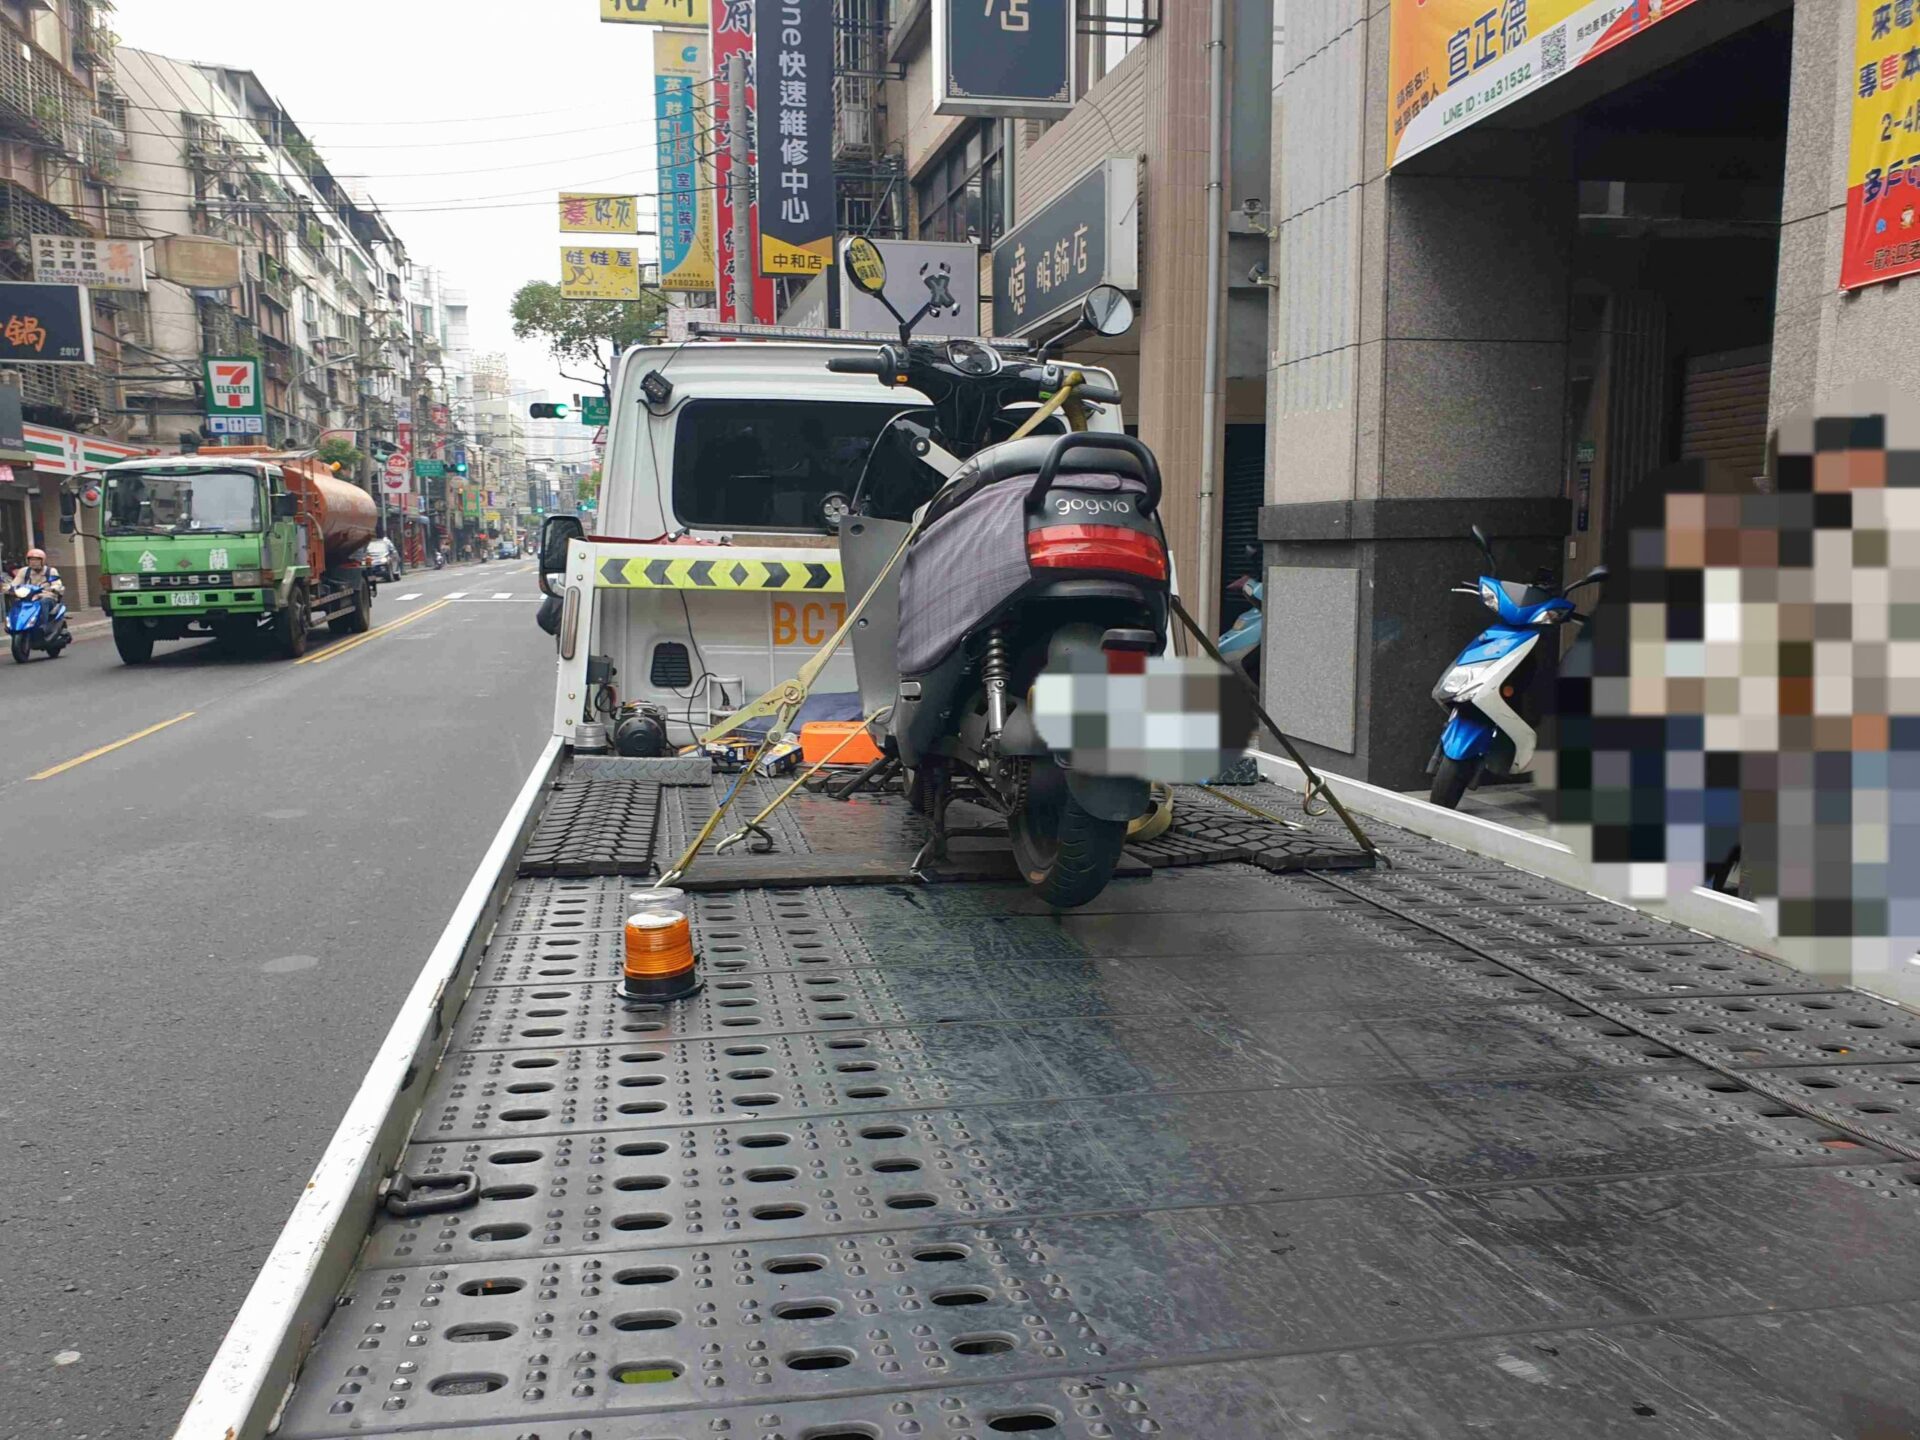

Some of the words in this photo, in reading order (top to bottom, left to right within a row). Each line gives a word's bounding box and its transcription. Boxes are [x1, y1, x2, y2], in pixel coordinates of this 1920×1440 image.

[1872, 0, 1920, 41] 來電
[1447, 0, 1527, 87] 宣正德
[1443, 102, 1463, 125] LINE
[1484, 62, 1531, 103] aa31532
[779, 50, 809, 223] 快速維修中心
[773, 253, 822, 270] 中和店
[1036, 223, 1088, 294] 服飾店
[1055, 498, 1130, 516] gogoro
[138, 550, 158, 571] 金
[151, 574, 221, 586] FUSO
